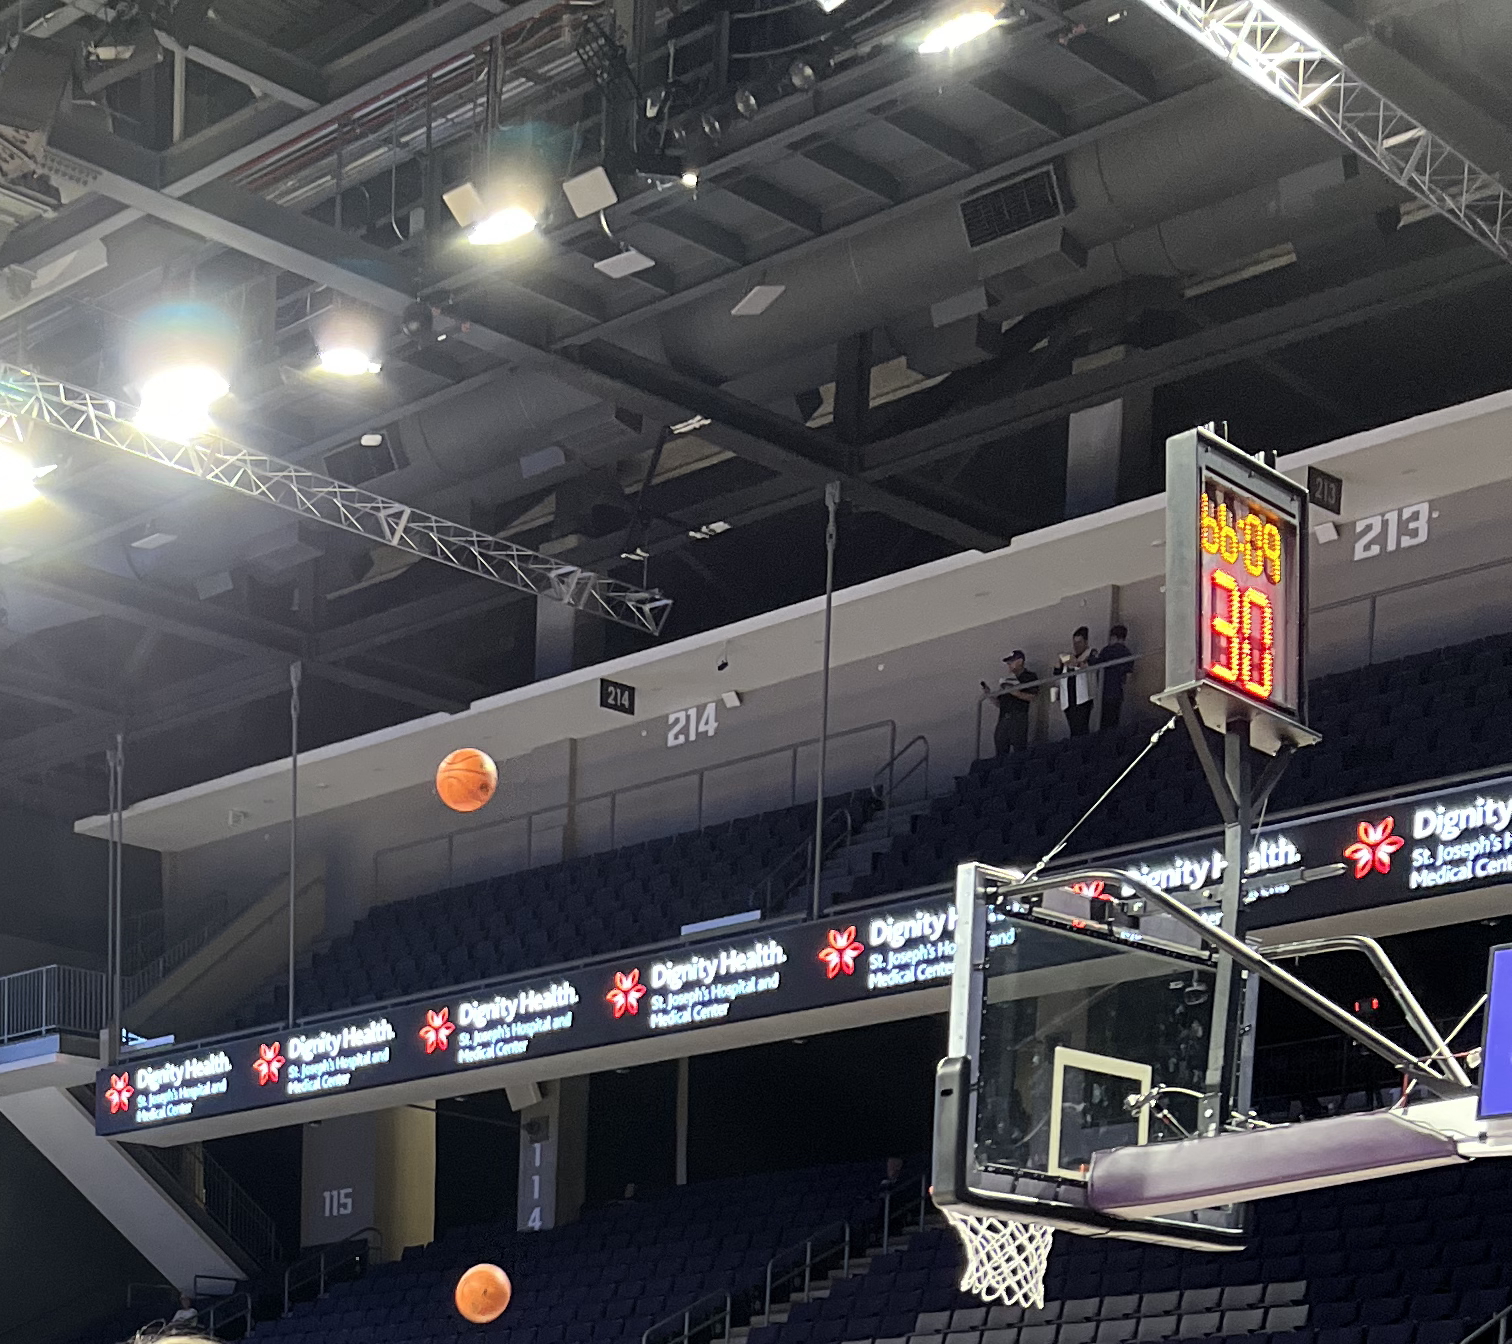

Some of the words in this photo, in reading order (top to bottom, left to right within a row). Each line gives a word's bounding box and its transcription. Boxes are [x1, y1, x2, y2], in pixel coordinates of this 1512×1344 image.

[1315, 477, 1336, 504] 213
[1354, 502, 1430, 561] 213
[1211, 568, 1273, 700] 30
[608, 686, 629, 709] 214
[667, 703, 719, 747] 214
[1412, 847, 1434, 867] St.
[1435, 833, 1502, 866] Joseph's
[1409, 860, 1473, 889] Medical
[869, 909, 946, 948] Dignity
[888, 943, 936, 970] Joseph's
[989, 927, 1015, 947] and
[651, 956, 718, 990] Dignity
[868, 967, 915, 990] Medical
[460, 995, 519, 1028] Dignity
[322, 1188, 353, 1218] 115
